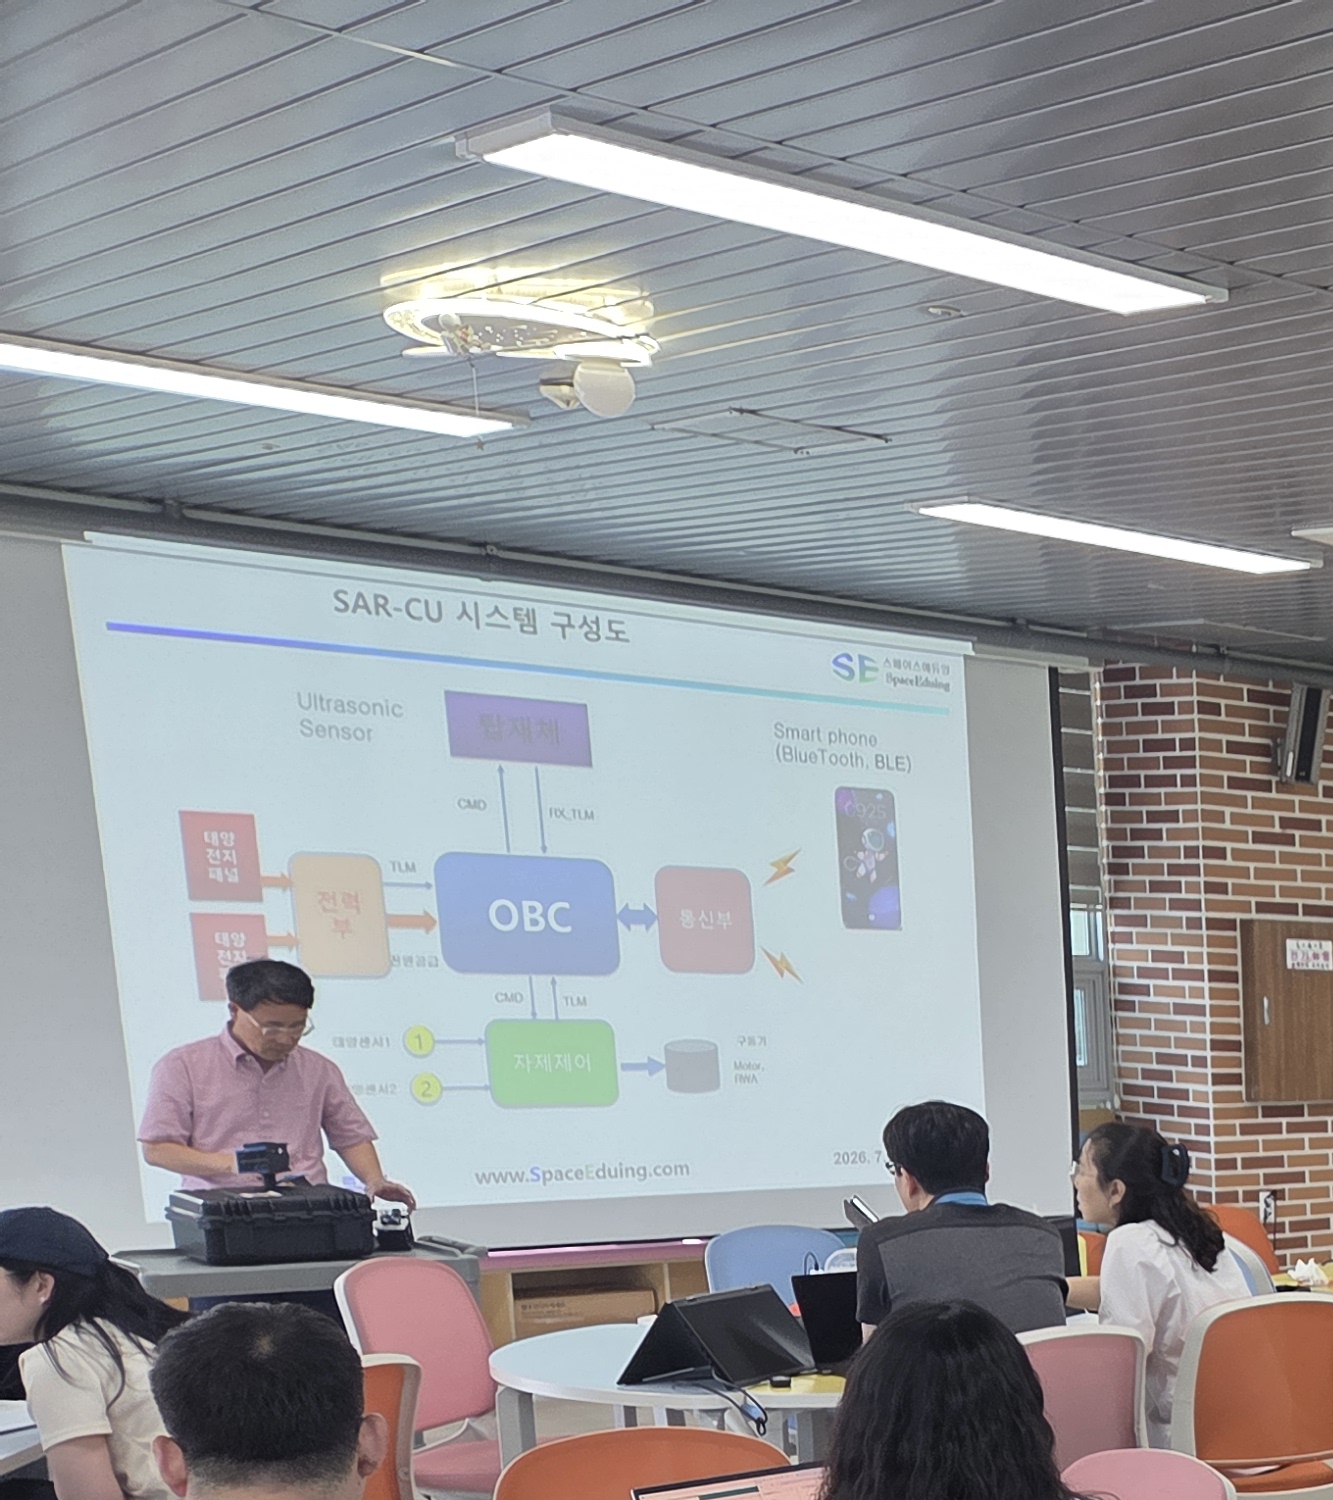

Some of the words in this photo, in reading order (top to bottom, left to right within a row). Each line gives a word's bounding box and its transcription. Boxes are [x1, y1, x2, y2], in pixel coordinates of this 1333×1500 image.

[333, 589, 443, 623] SAR-CU
[456, 600, 538, 635] 시스템
[551, 611, 630, 643] 구성도
[832, 652, 879, 684] SE
[886, 672, 950, 692] SpaceEduing
[297, 691, 404, 719] Ultrasonic
[299, 718, 373, 742] Sensor
[774, 722, 822, 743] Smart
[828, 727, 878, 748] phone
[775, 742, 870, 770] (BlueTooth,
[875, 753, 912, 774] BLE)
[457, 798, 487, 811] CMD
[204, 831, 236, 847] 태양
[206, 848, 238, 866] 전지
[208, 867, 239, 883] 패널
[391, 861, 416, 874] TLM
[488, 899, 572, 933] OBC
[679, 909, 733, 931] 통신부
[214, 931, 246, 947] 태양
[495, 992, 524, 1004] CMD
[562, 995, 587, 1008] TLM
[413, 1033, 424, 1050] 1
[733, 1060, 765, 1072] Motor,
[420, 1080, 432, 1098] 2
[833, 1150, 871, 1166] 2026.
[475, 1160, 690, 1186] www.SpaceEduing.com
